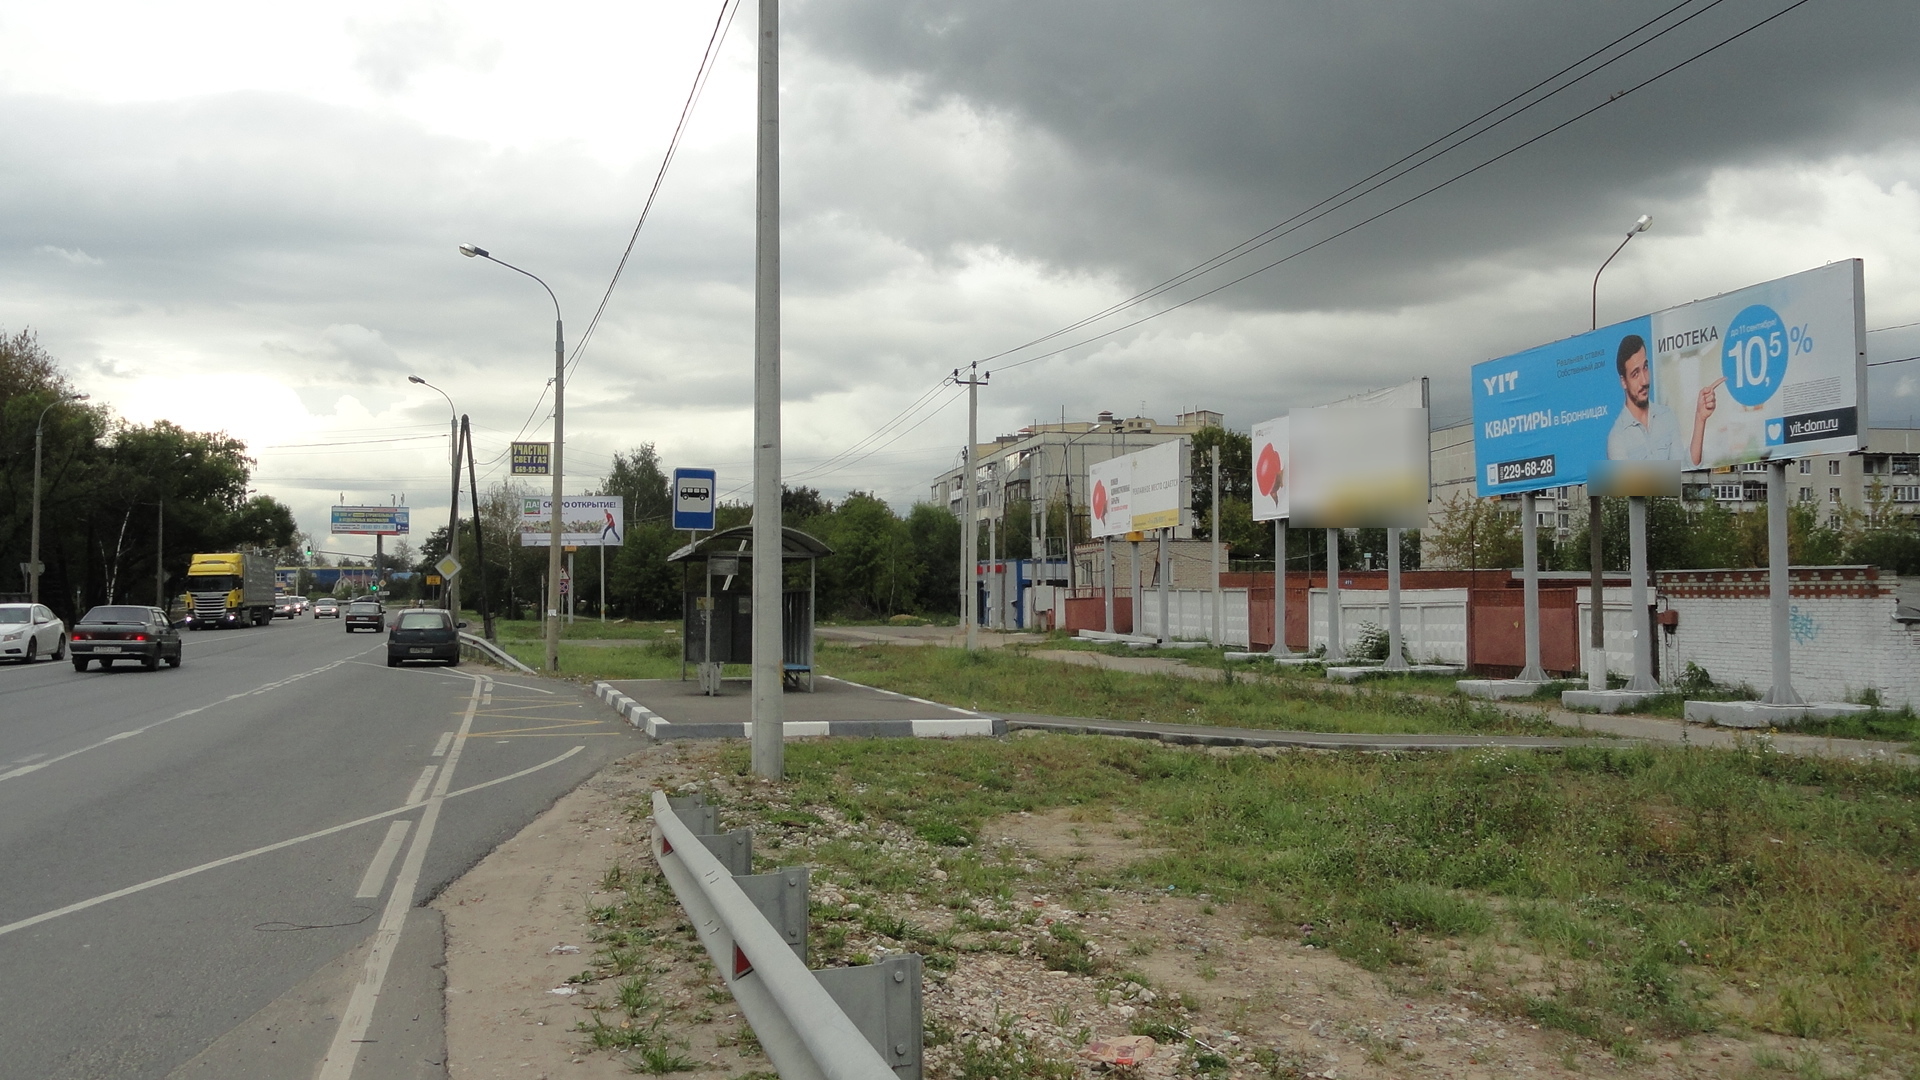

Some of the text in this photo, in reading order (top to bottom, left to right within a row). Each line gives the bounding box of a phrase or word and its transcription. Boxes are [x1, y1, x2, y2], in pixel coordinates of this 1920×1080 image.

[1658, 326, 1719, 353] ИПОТЕКА
[1790, 323, 1813, 356] %
[1585, 348, 1605, 360] ставка
[1594, 360, 1606, 370] дом
[1483, 370, 1518, 396] YIT
[1485, 404, 1608, 439] КВАРТИРЫ в Бронницах
[1789, 418, 1839, 437] yit-dom.ru
[513, 444, 548, 455] УЧАСТКИ
[515, 465, 546, 473] 669-93-99
[1504, 458, 1553, 480] 229-68-28
[525, 501, 540, 509] ДА!
[571, 501, 617, 509] ОТКРЫТИЕ!
